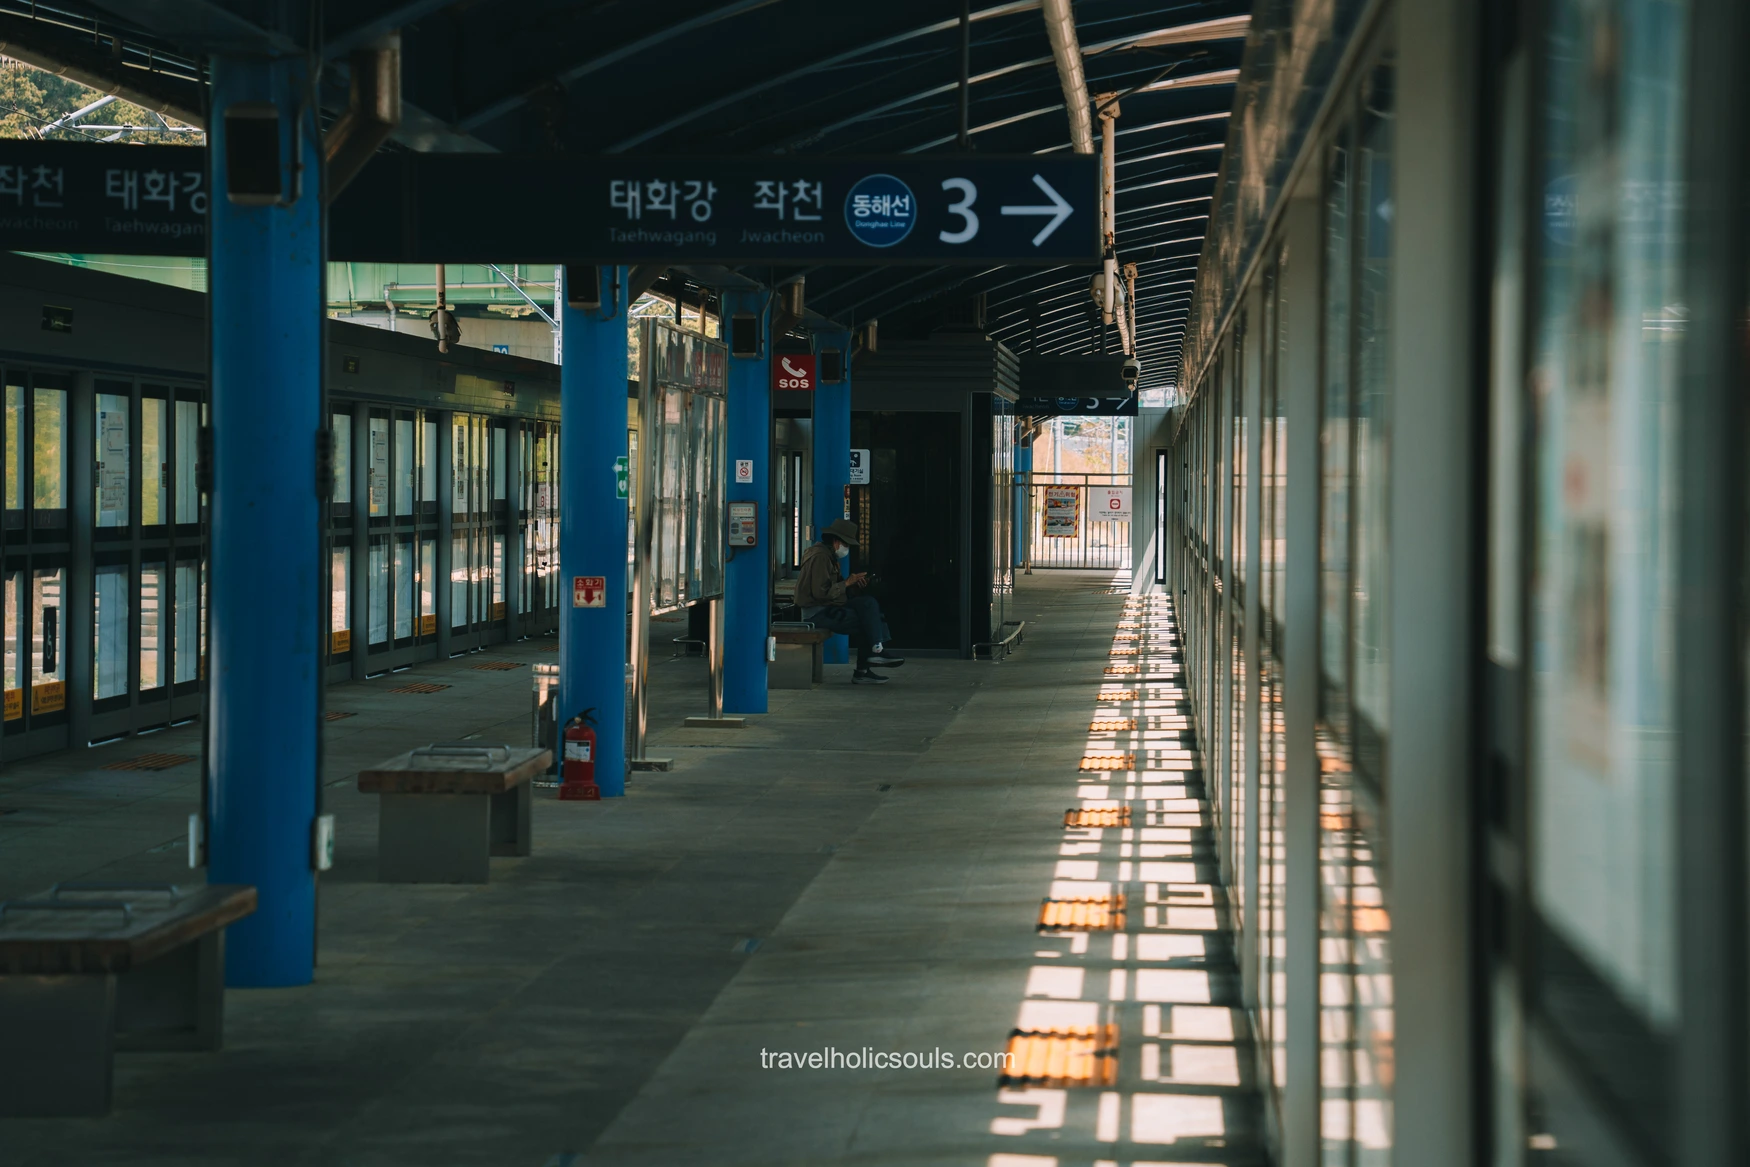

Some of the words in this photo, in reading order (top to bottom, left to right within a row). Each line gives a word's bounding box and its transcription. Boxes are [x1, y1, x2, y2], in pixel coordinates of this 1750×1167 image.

[609, 178, 718, 222] 태화강
[753, 178, 823, 221] 좌천
[852, 194, 910, 217] 동해선
[939, 176, 980, 244] 3
[0, 215, 79, 232] wacheon
[104, 216, 205, 238] Taehwagan
[855, 219, 889, 229] Donghae
[890, 219, 906, 228] Line
[609, 227, 718, 247] Taehwagang
[740, 228, 825, 244] Jwacheon
[778, 378, 810, 389] SOS
[576, 578, 603, 587] 소화기
